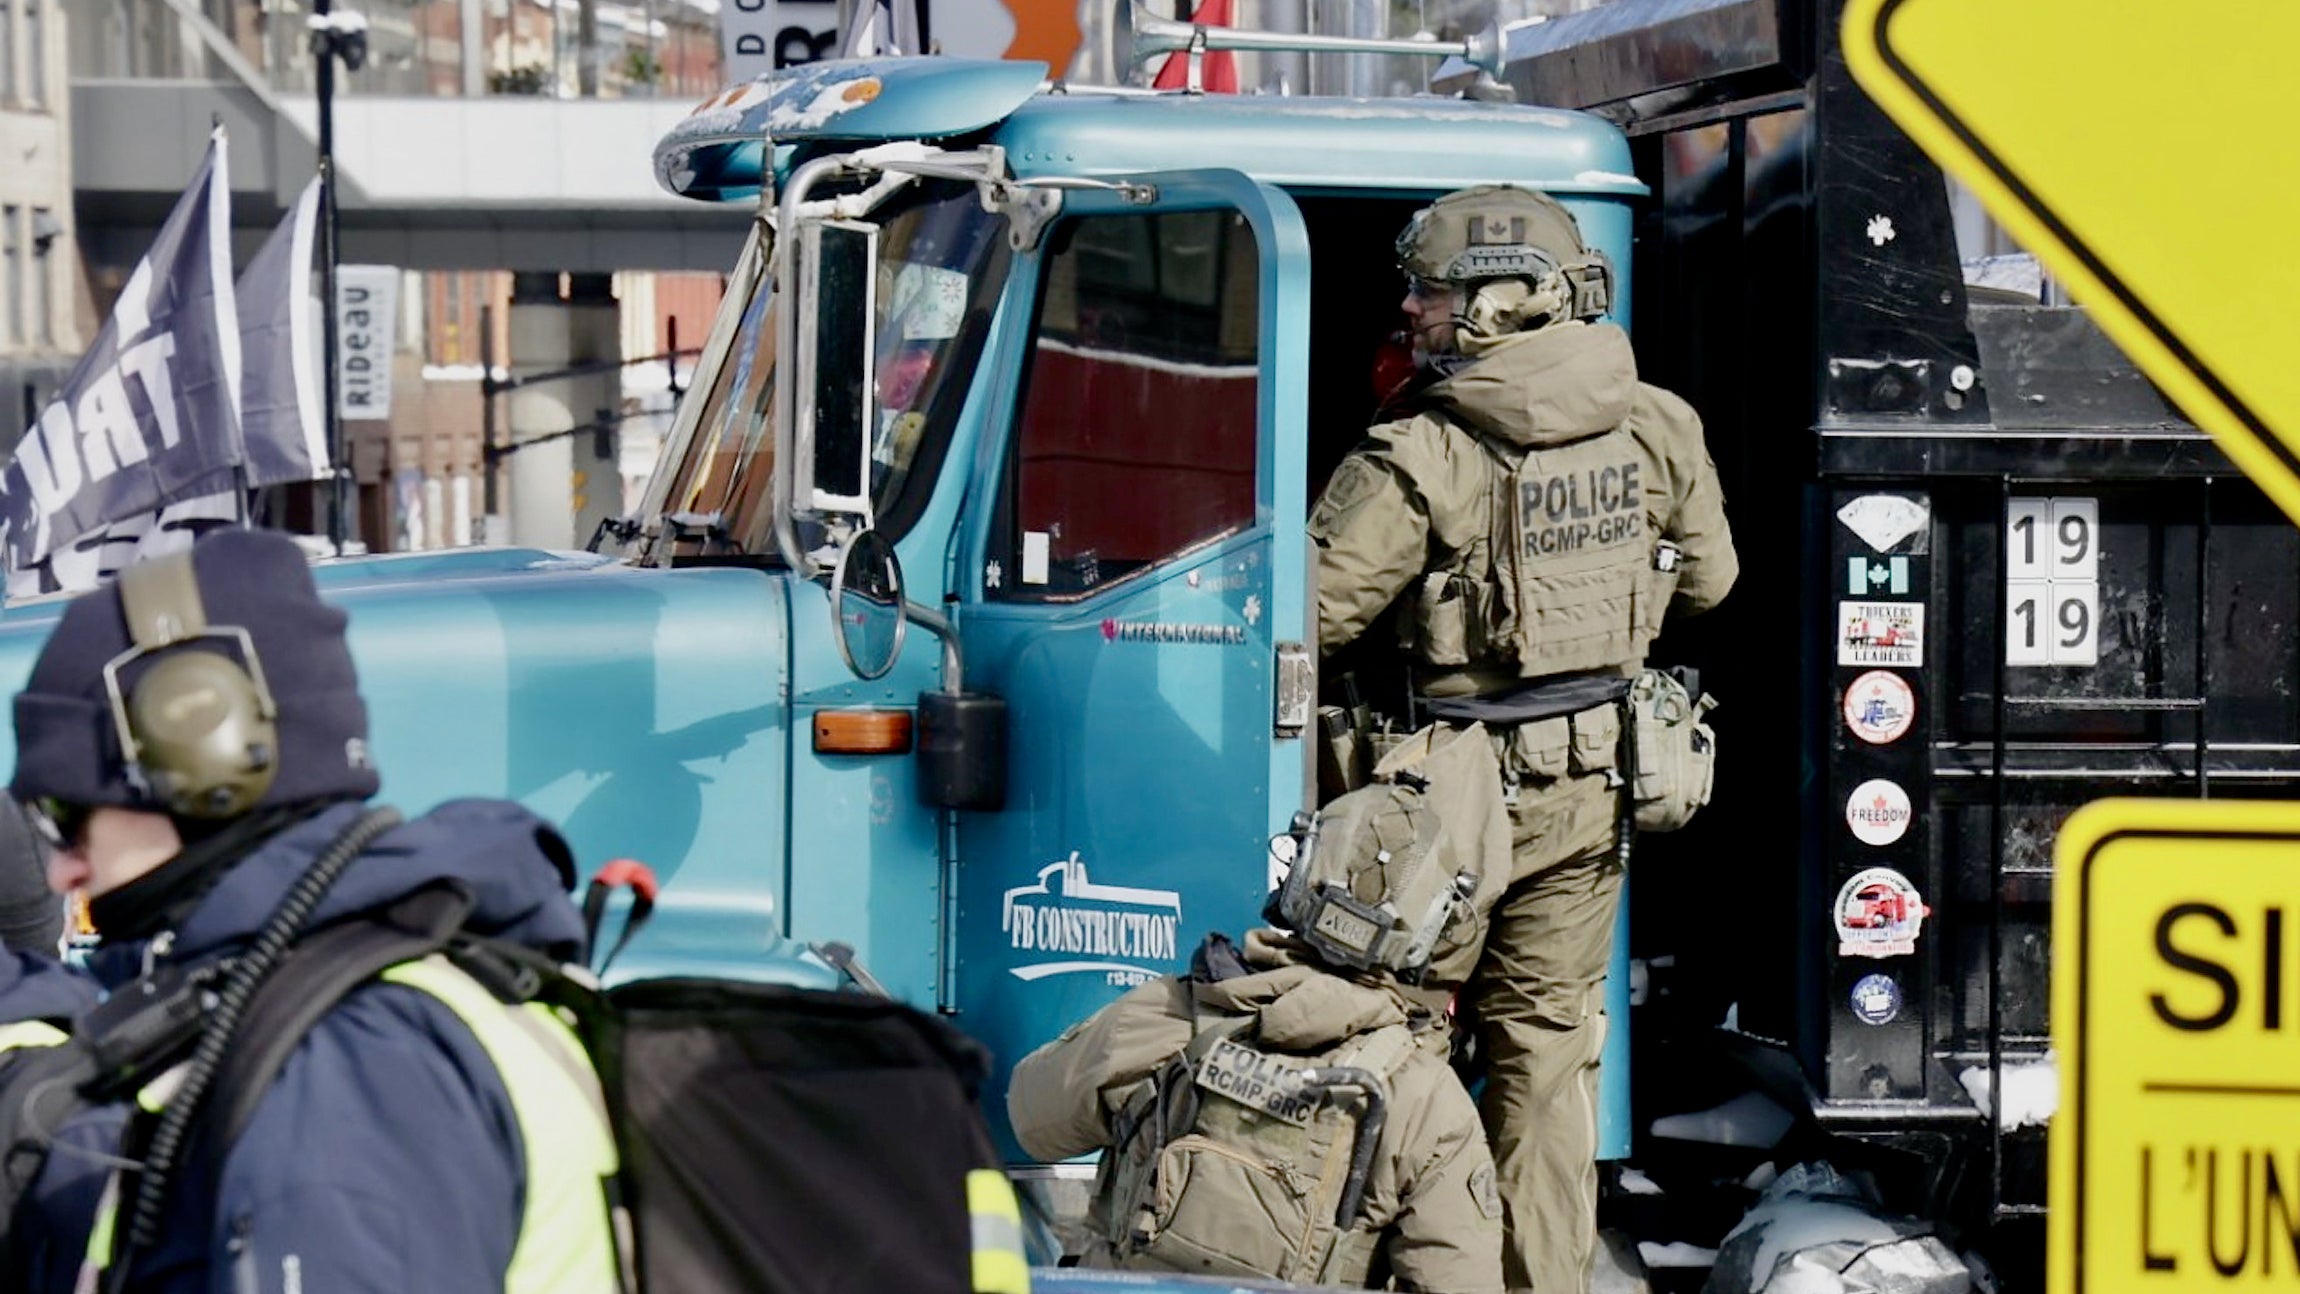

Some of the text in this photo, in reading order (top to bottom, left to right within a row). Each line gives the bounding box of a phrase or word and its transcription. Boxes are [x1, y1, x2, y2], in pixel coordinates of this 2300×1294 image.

[1520, 462, 1640, 528] POLICE
[1523, 512, 1641, 558] RCMP-GRC
[2013, 514, 2090, 565] 19
[1118, 622, 1247, 645] INTERNATIONAL
[2014, 598, 2090, 648] 19
[1855, 651, 1913, 662] LEADERS
[1851, 808, 1909, 822] FREEDOM
[1011, 904, 1177, 961] FB CONSTRUCTION
[2148, 902, 2283, 1033] SI
[1205, 1064, 1311, 1122] RCMP-GRC
[2141, 1147, 2300, 1278] L'UN
